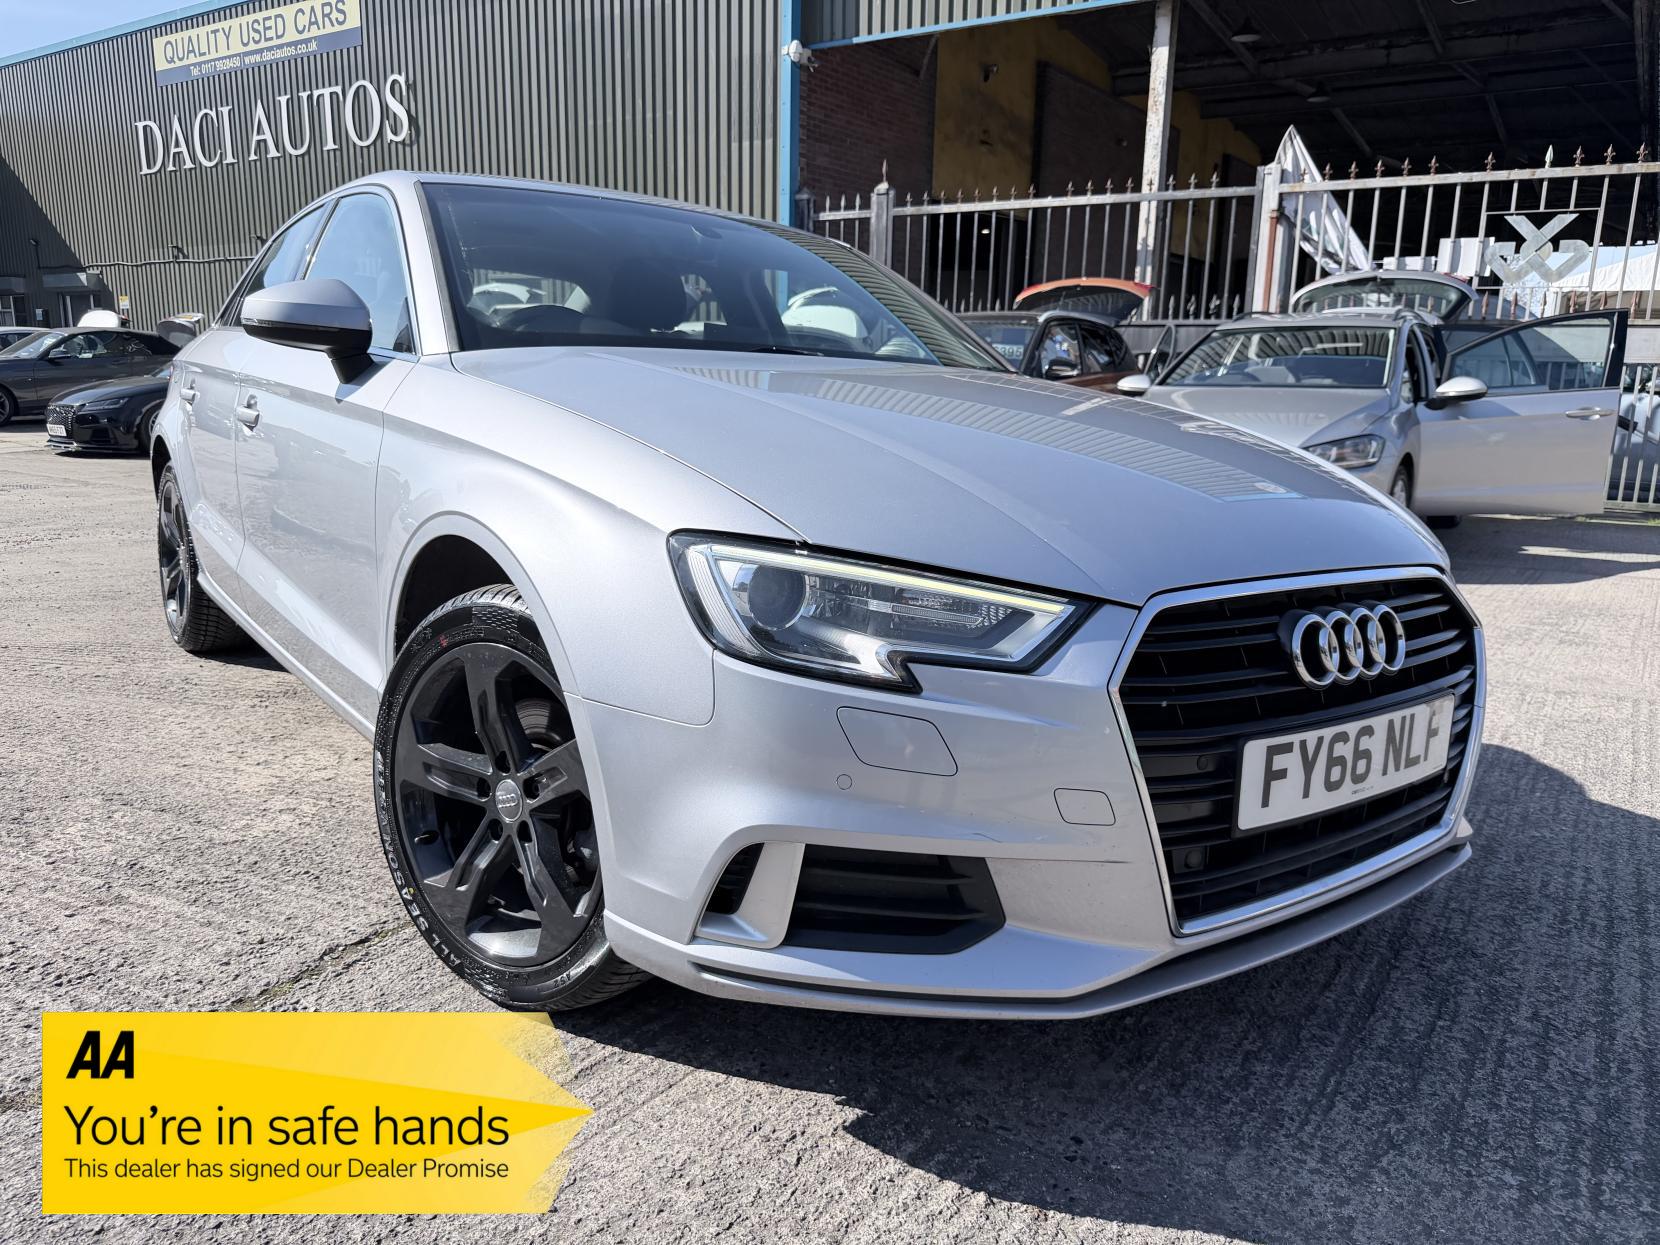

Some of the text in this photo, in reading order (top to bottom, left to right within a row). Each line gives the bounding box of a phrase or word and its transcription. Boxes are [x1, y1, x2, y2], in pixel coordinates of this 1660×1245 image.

[163, 0, 347, 65] QUALITY USED CARS
[243, 39, 318, 65] www.daciautos.co.uk
[190, 65, 201, 77] Tel:
[201, 62, 215, 75] 0117
[134, 72, 411, 175] DACI AUTOS
[1260, 724, 1375, 809] FY66
